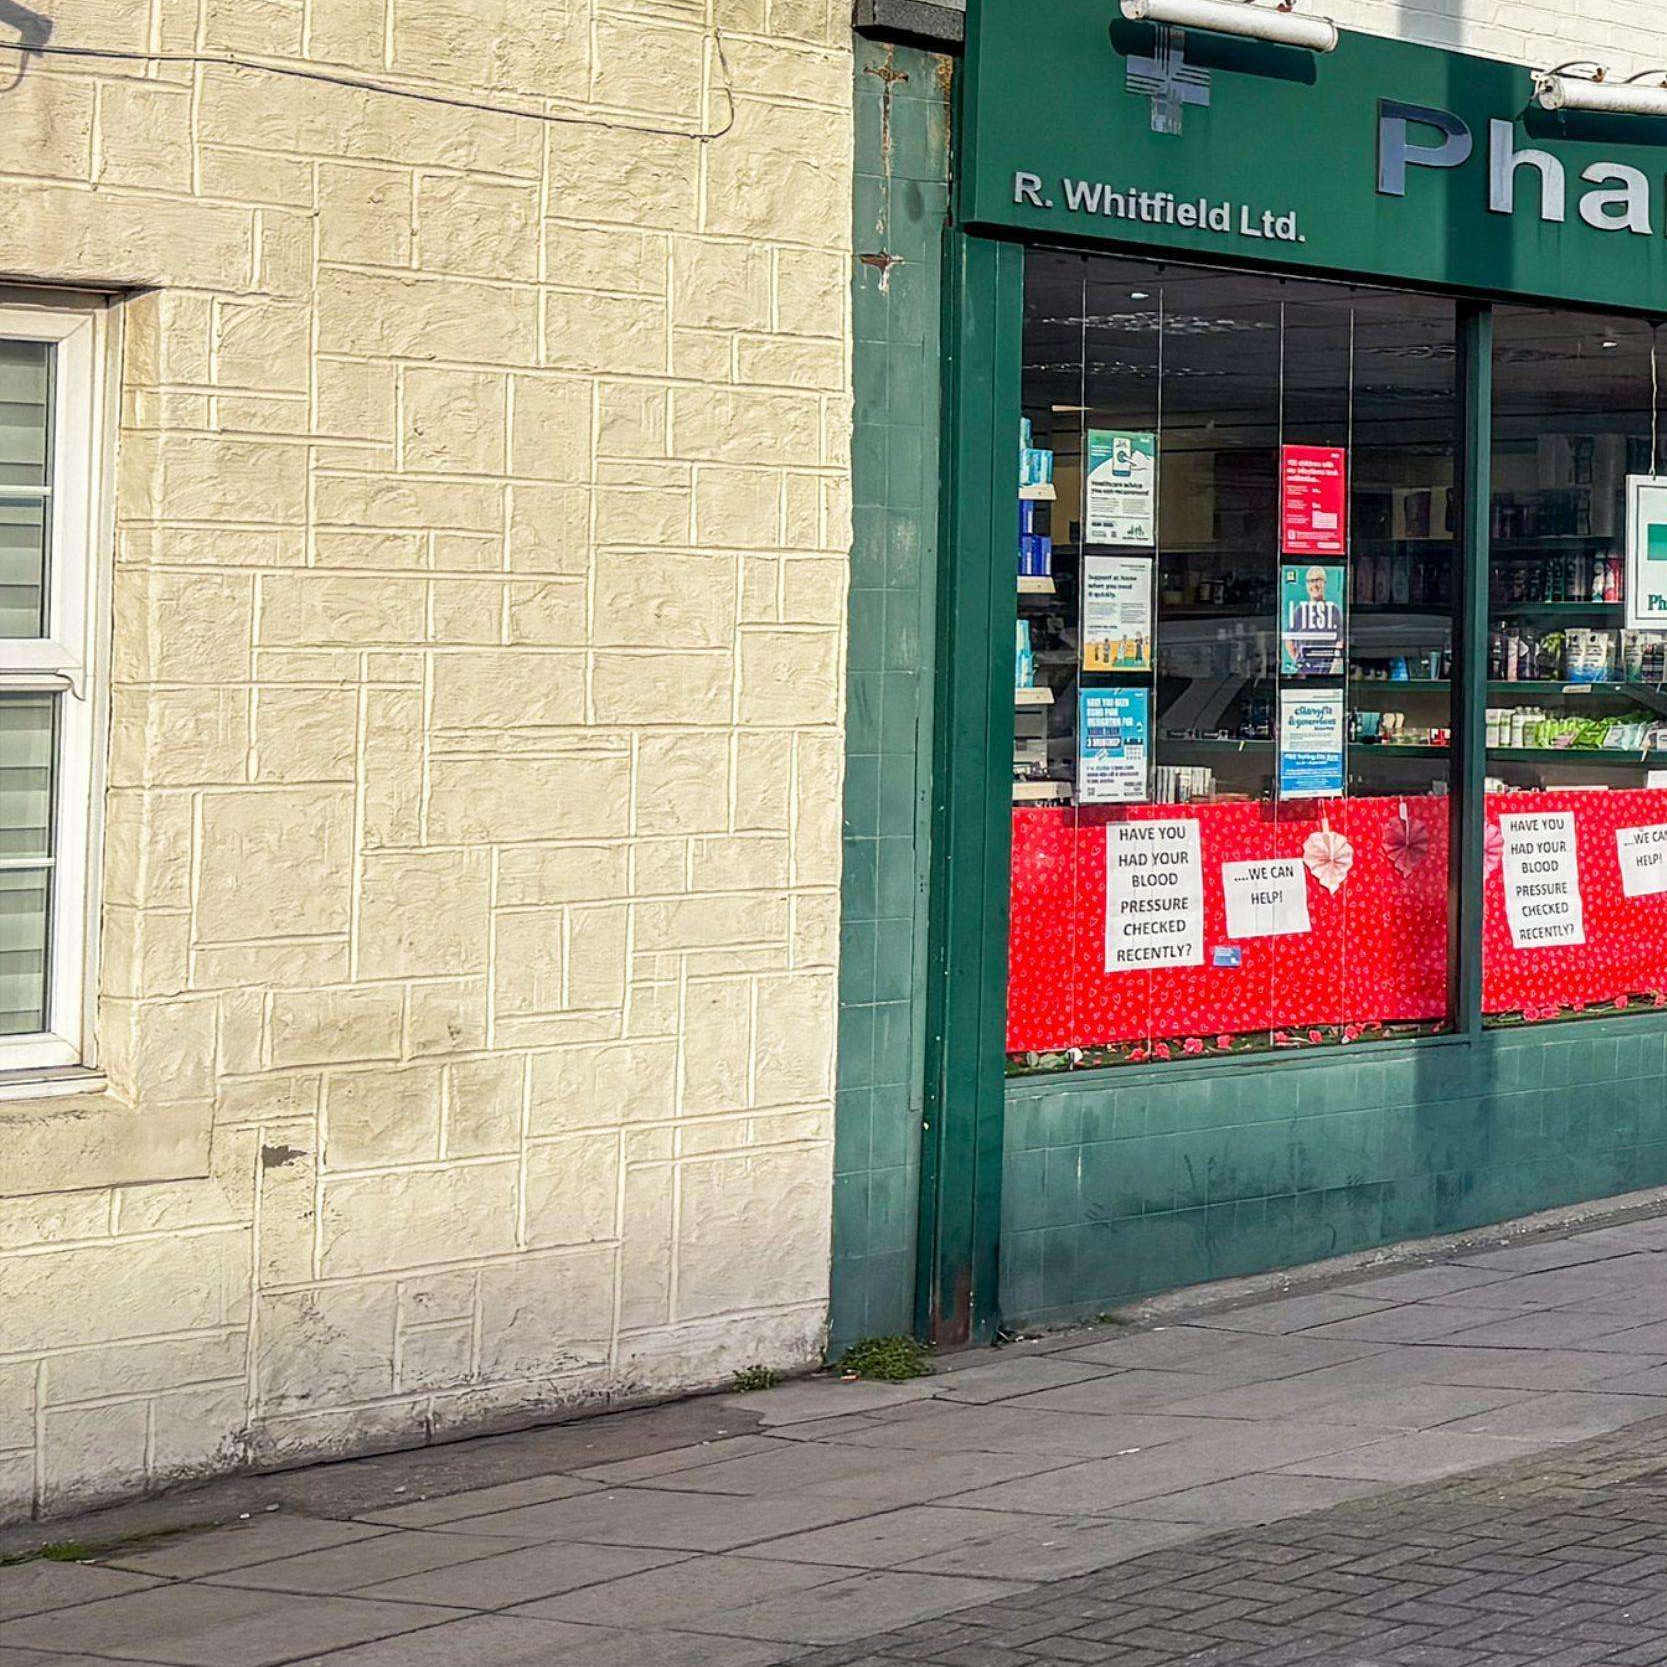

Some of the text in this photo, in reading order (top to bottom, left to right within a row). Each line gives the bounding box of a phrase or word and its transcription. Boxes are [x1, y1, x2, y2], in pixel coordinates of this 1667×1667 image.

[1013, 171, 1306, 243] R. Whitfield Ltd.
[1289, 599, 1338, 630] I TEST.
[1510, 818, 1565, 832] HAVE YOU
[1119, 826, 1186, 841] HAVE YOU
[1511, 841, 1567, 855] HAD YOUR
[1119, 851, 1189, 867] HAD YOUR
[1636, 853, 1663, 867] HELP!
[1270, 866, 1294, 880] CAN
[1521, 860, 1559, 874] BLOOD
[1132, 873, 1178, 888] BLOOD
[1516, 882, 1568, 897] PRESSURE
[1121, 897, 1189, 913] PRESSURE
[1251, 890, 1283, 905] HELP!
[1522, 902, 1569, 917] CHECKED
[1123, 920, 1186, 936] CHECKED
[1519, 923, 1575, 940] RECENTLY?
[1117, 944, 1192, 962] RECENTLY?
